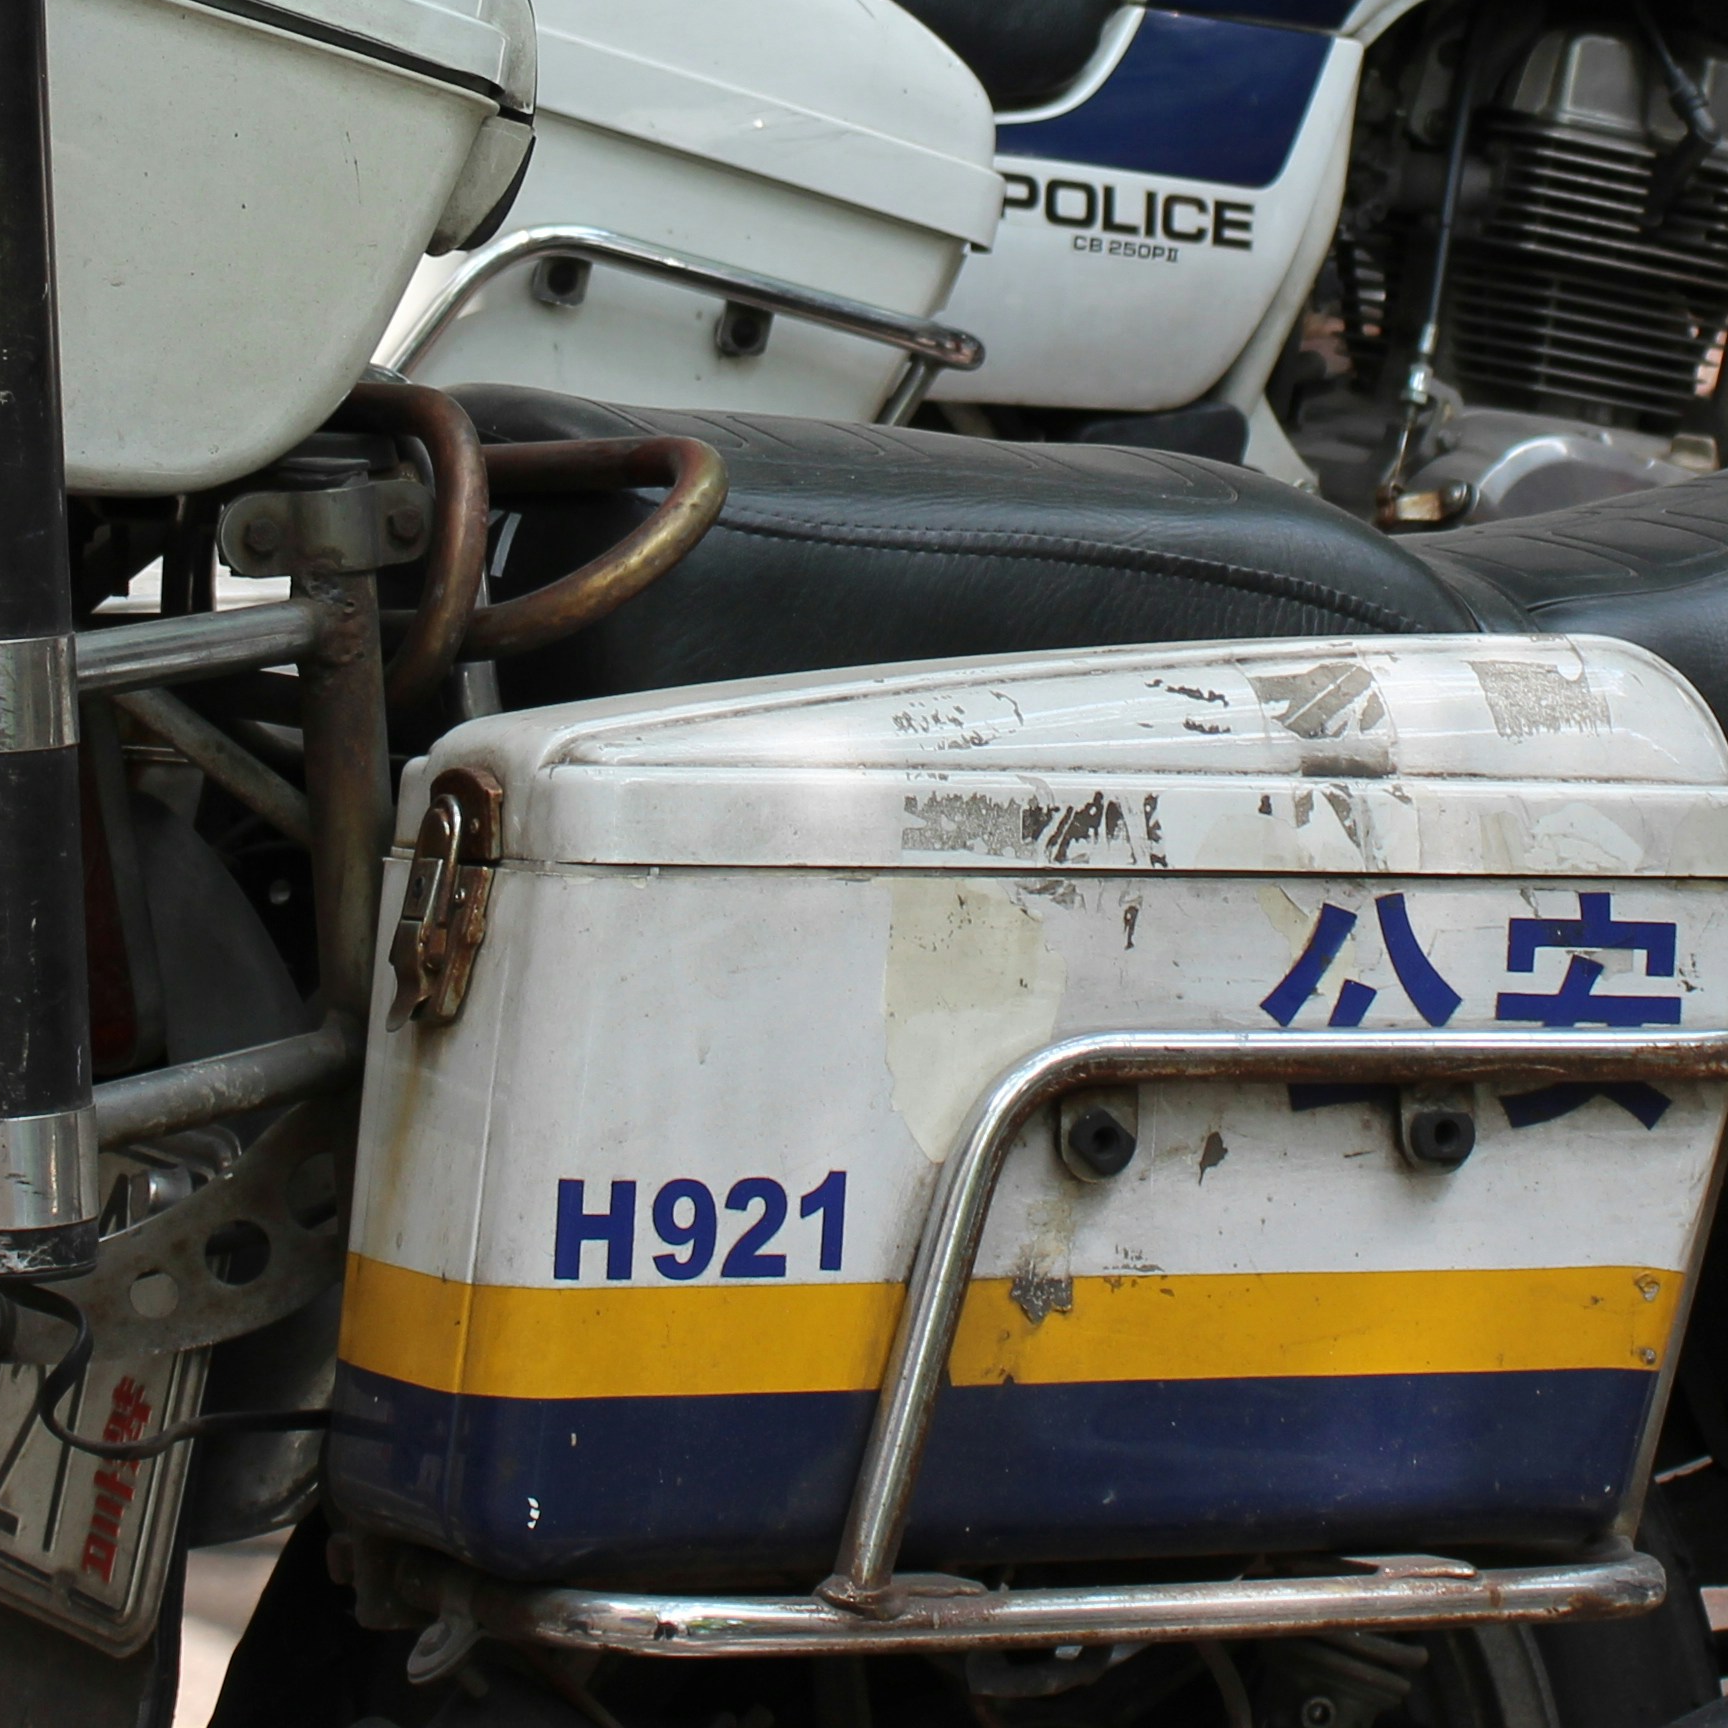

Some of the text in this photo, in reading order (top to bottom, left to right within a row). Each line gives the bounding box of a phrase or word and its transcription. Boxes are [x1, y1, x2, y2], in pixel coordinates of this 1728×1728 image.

[1001, 173, 1255, 252] POLICE
[1072, 235, 1103, 253] CB
[1259, 892, 1682, 1130] 公安
[553, 1170, 848, 1281] H921
